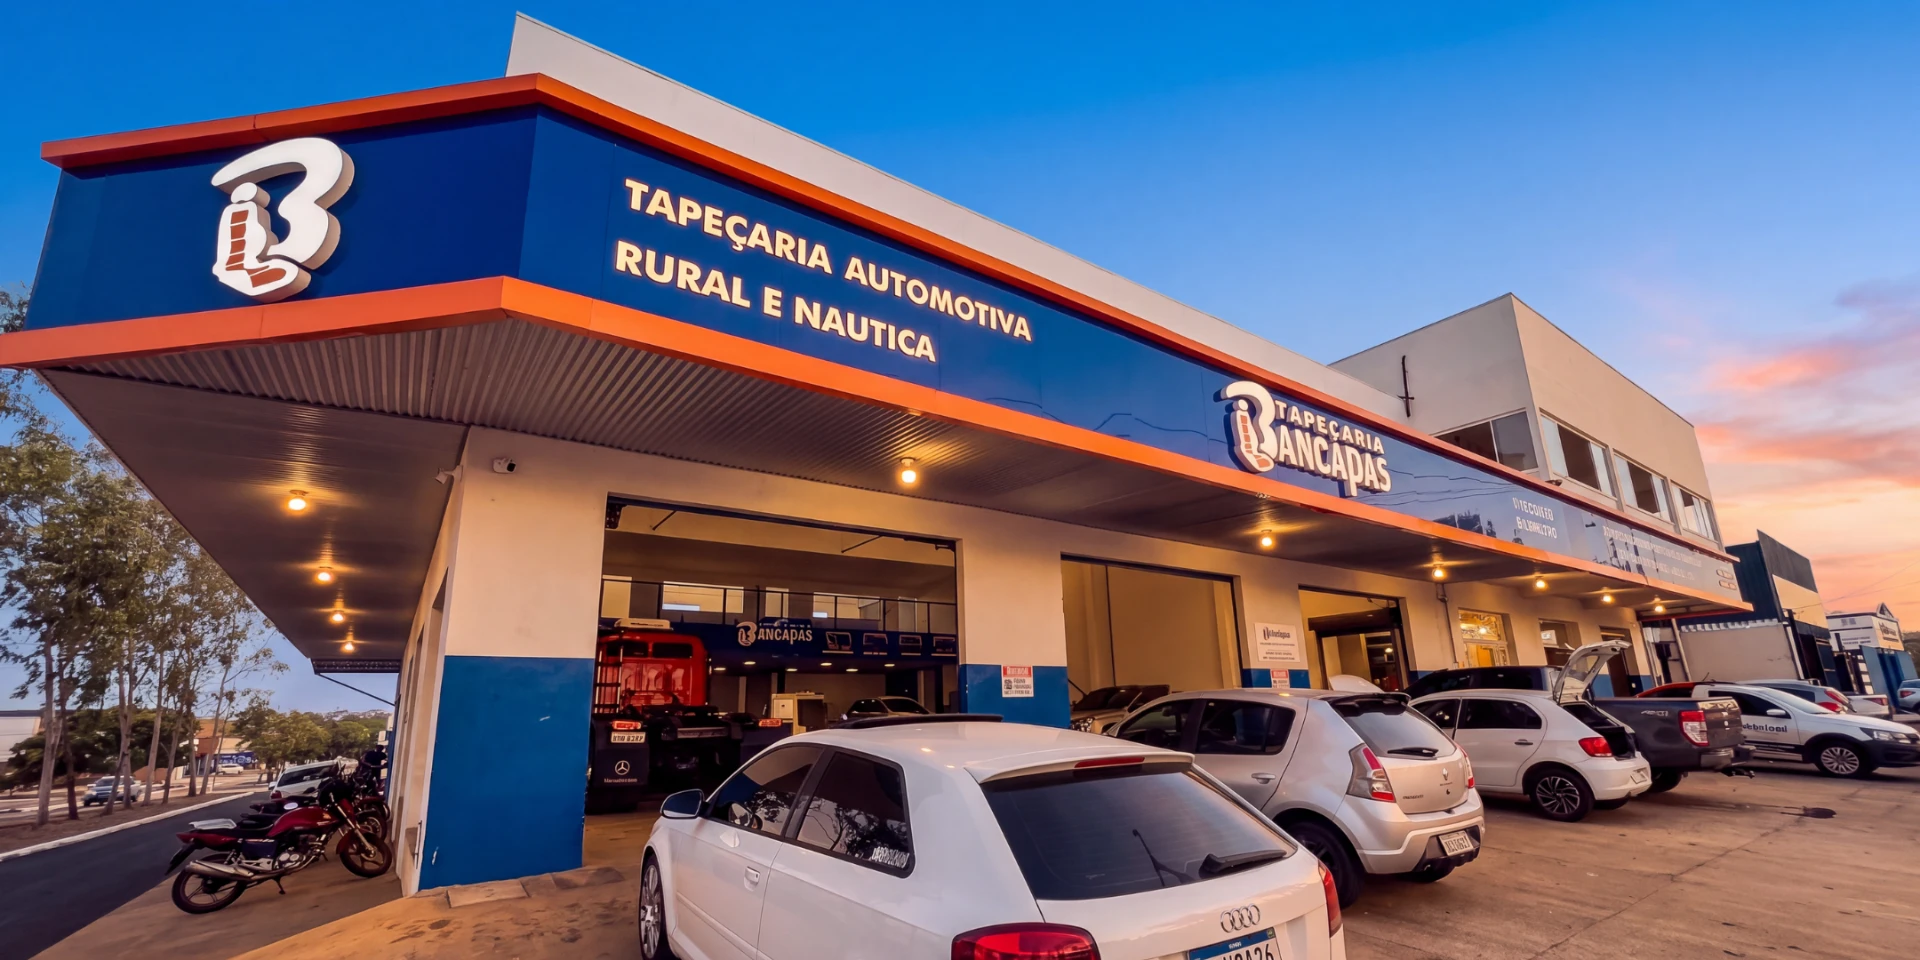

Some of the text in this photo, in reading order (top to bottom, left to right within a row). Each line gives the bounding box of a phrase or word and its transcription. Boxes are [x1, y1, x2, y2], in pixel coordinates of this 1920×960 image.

[614, 240, 937, 363] RURAL E NAUTICA
[624, 177, 1033, 342] TAPEÇARIA AUTOMOTIVA
[1274, 400, 1385, 454] TAPEÇARIA
